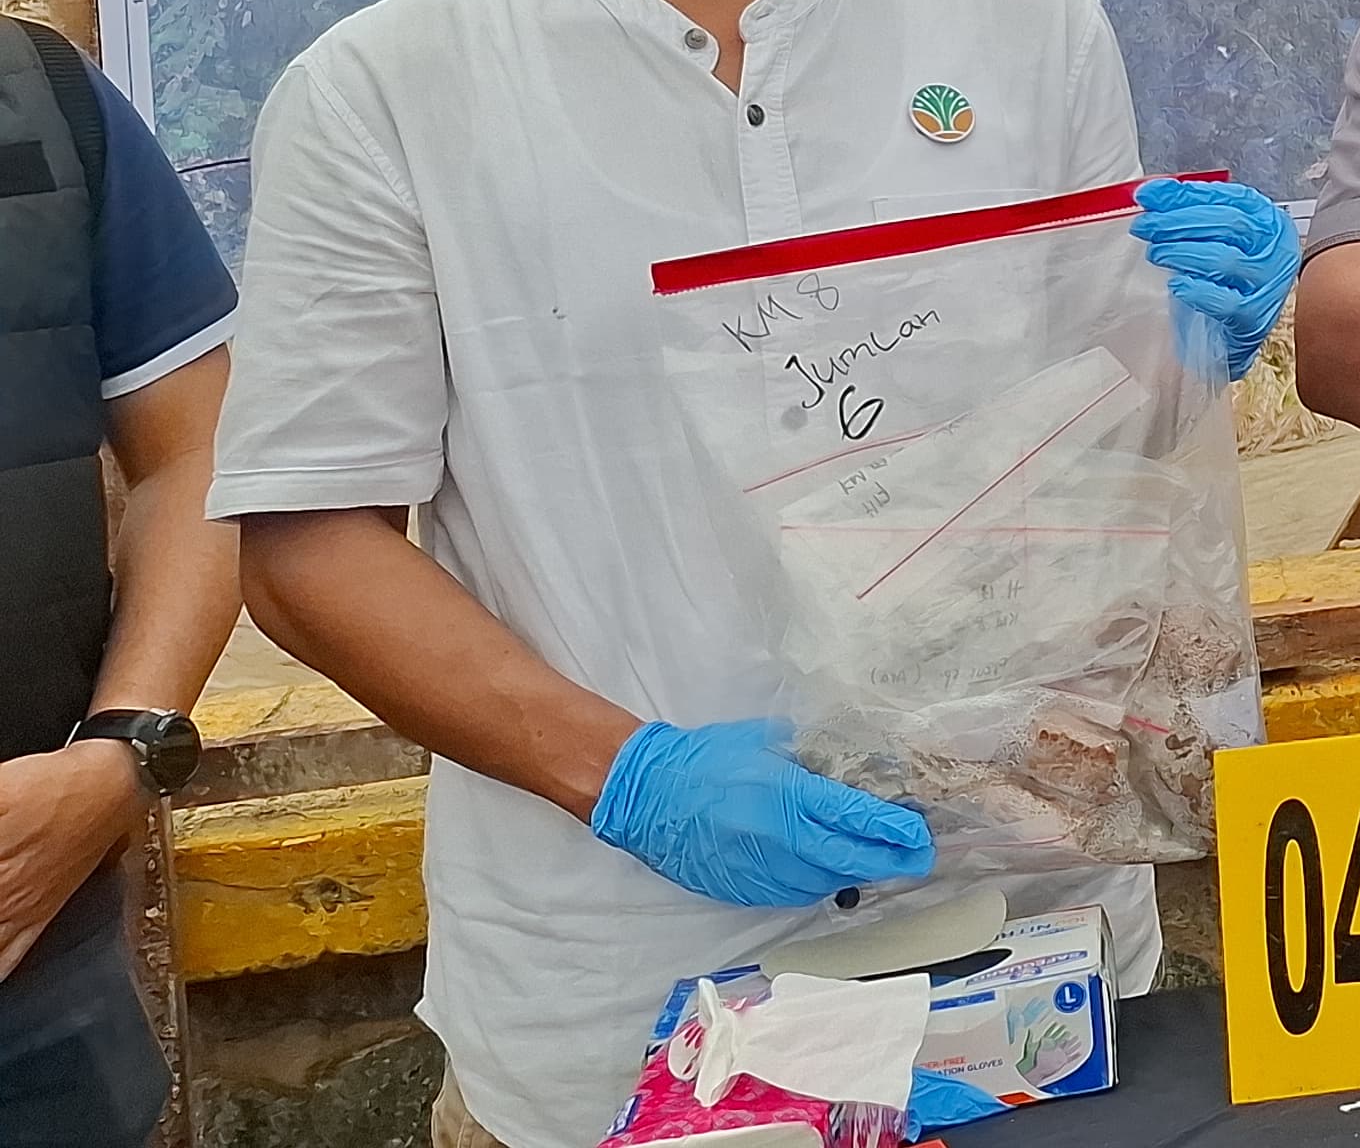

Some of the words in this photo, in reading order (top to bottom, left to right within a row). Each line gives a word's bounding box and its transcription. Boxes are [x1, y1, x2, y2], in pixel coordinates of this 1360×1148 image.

[721, 293, 804, 353] KM
[796, 272, 840, 311] 8
[838, 384, 885, 441] 6
[1064, 985, 1077, 1004] L
[966, 1058, 1004, 1073] GLOVES
